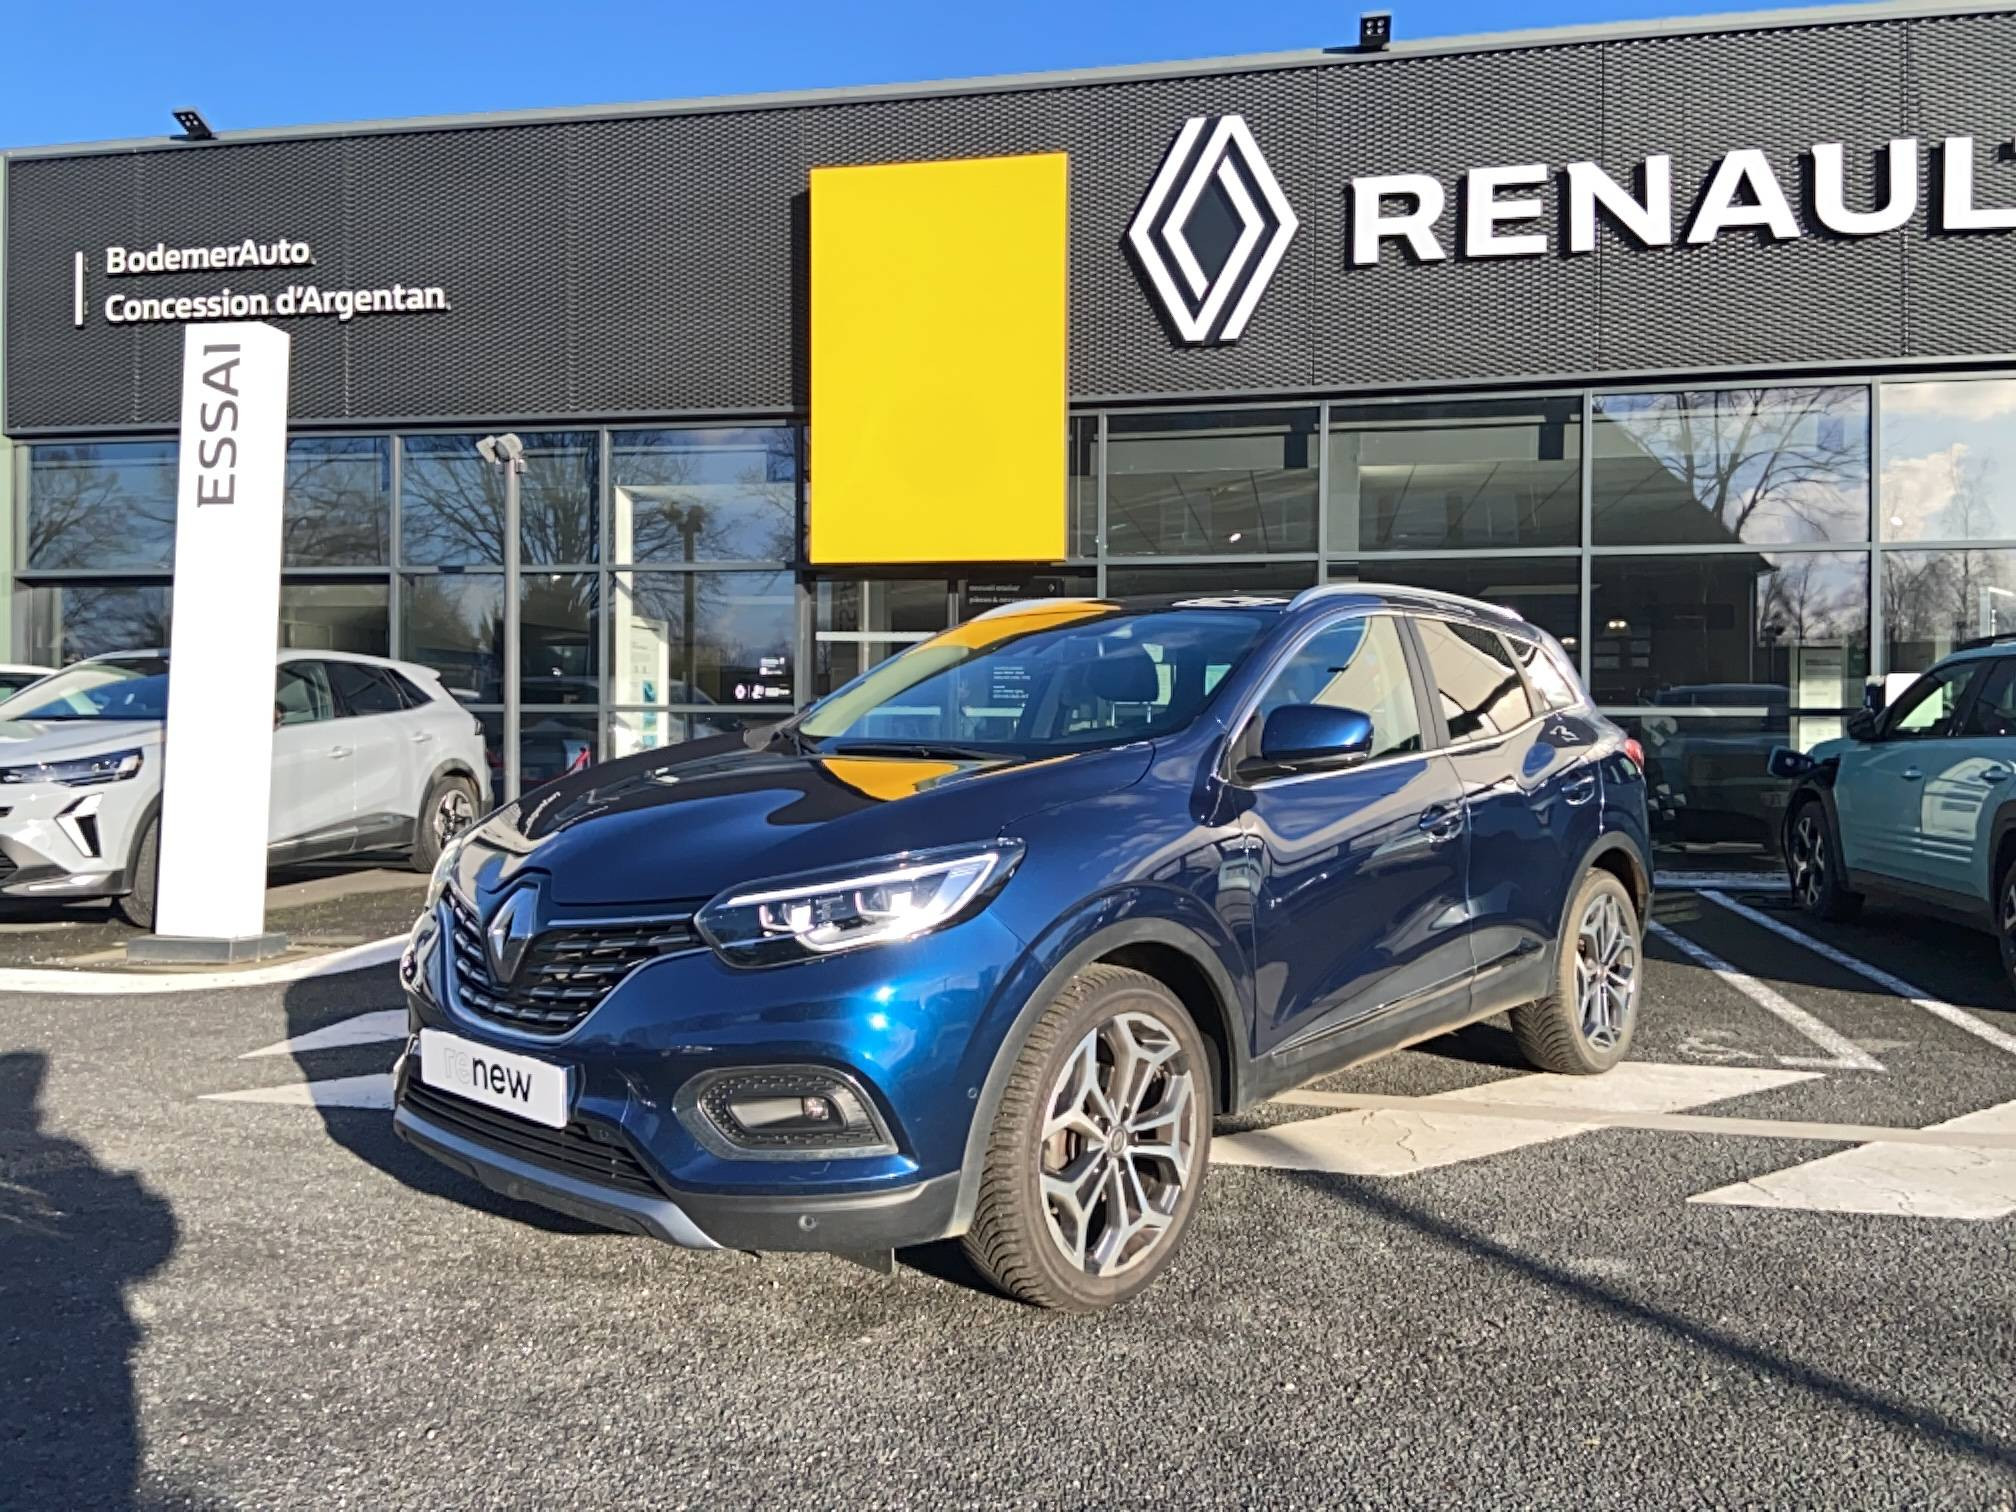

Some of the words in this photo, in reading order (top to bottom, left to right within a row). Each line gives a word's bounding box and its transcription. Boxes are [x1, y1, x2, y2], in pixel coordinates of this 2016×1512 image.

[1352, 135, 2016, 266] RENAUL
[106, 239, 310, 274] BodemerAuto
[105, 288, 269, 322] Concession
[276, 283, 446, 320] d'Argentan
[197, 343, 241, 508] ESSAI
[444, 1047, 532, 1102] renew
